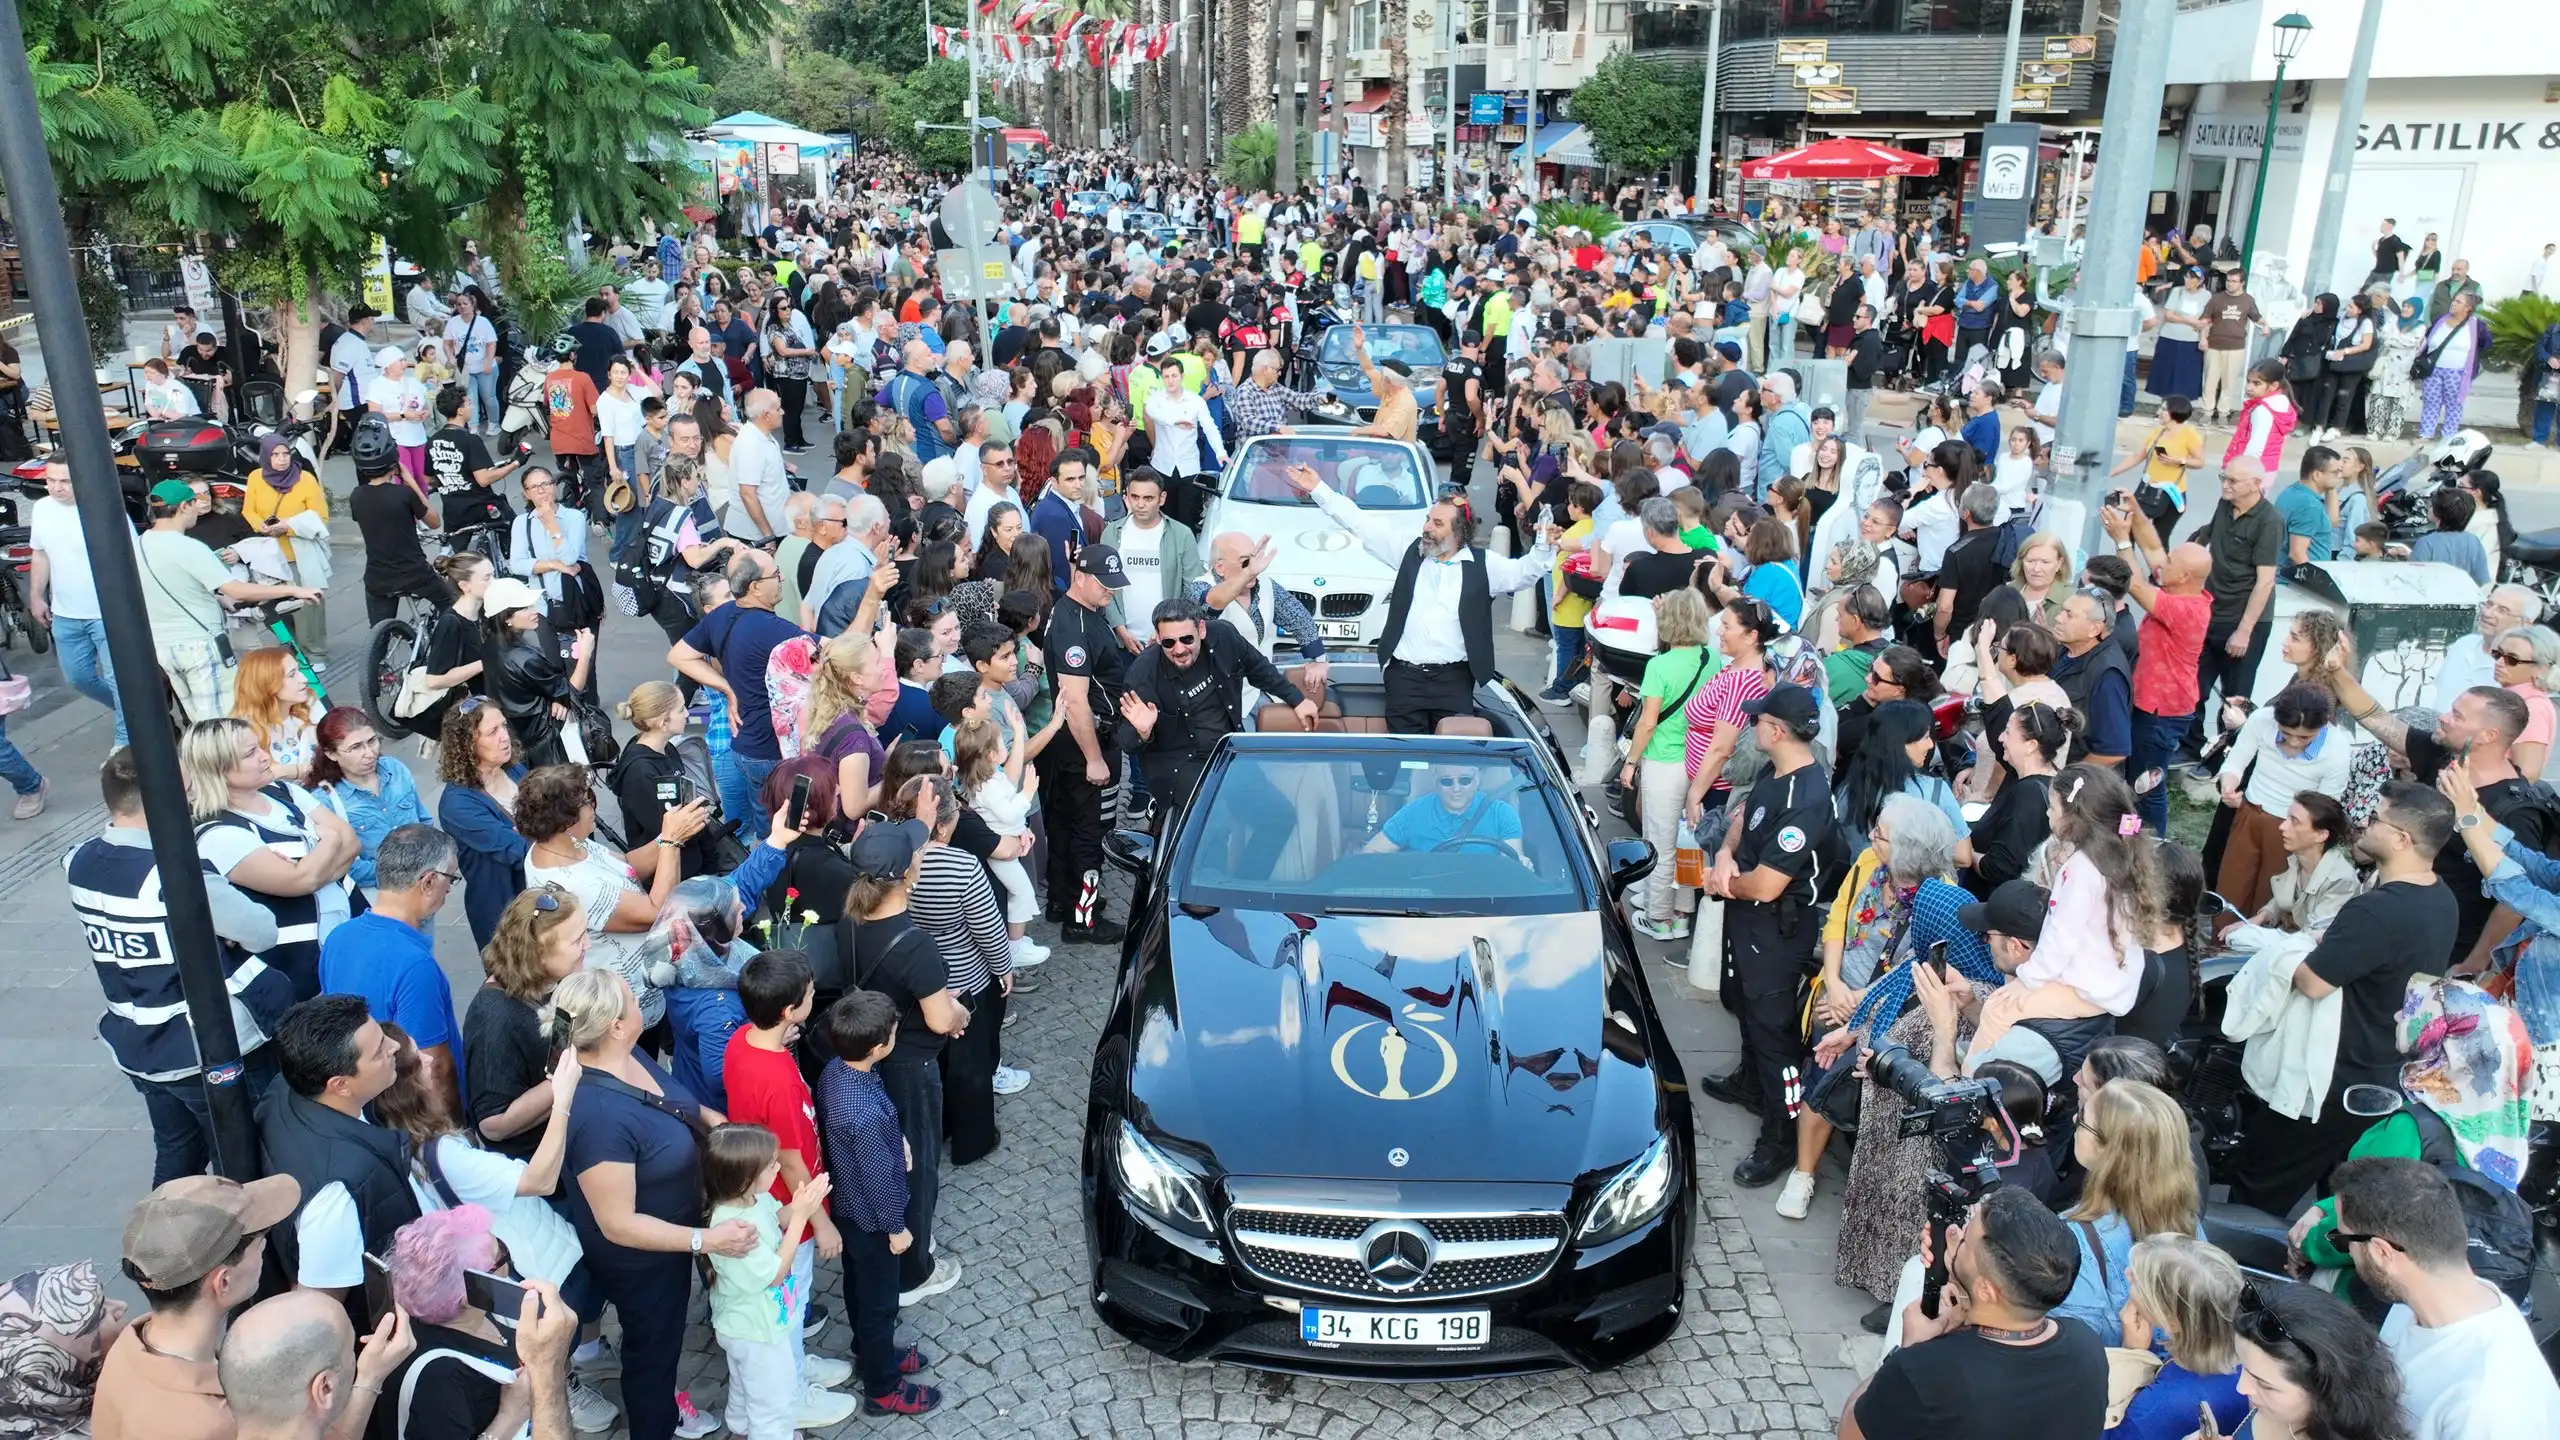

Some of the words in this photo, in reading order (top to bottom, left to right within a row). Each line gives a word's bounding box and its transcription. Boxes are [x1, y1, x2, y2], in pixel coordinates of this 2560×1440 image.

[2196, 124, 2229, 146] SATILIK
[2228, 125, 2236, 147] &
[2355, 123, 2526, 151] SATILIK
[2538, 122, 2560, 150] &
[1987, 181, 2021, 195] Wi-Fi
[1126, 556, 1161, 567] CURVED
[1339, 624, 1357, 636] 164
[1187, 680, 1208, 698] NEVER
[1305, 1325, 1318, 1334] TR
[1322, 1314, 1352, 1338] 34
[1370, 1317, 1419, 1340] KCG
[1438, 1315, 1481, 1340] 198
